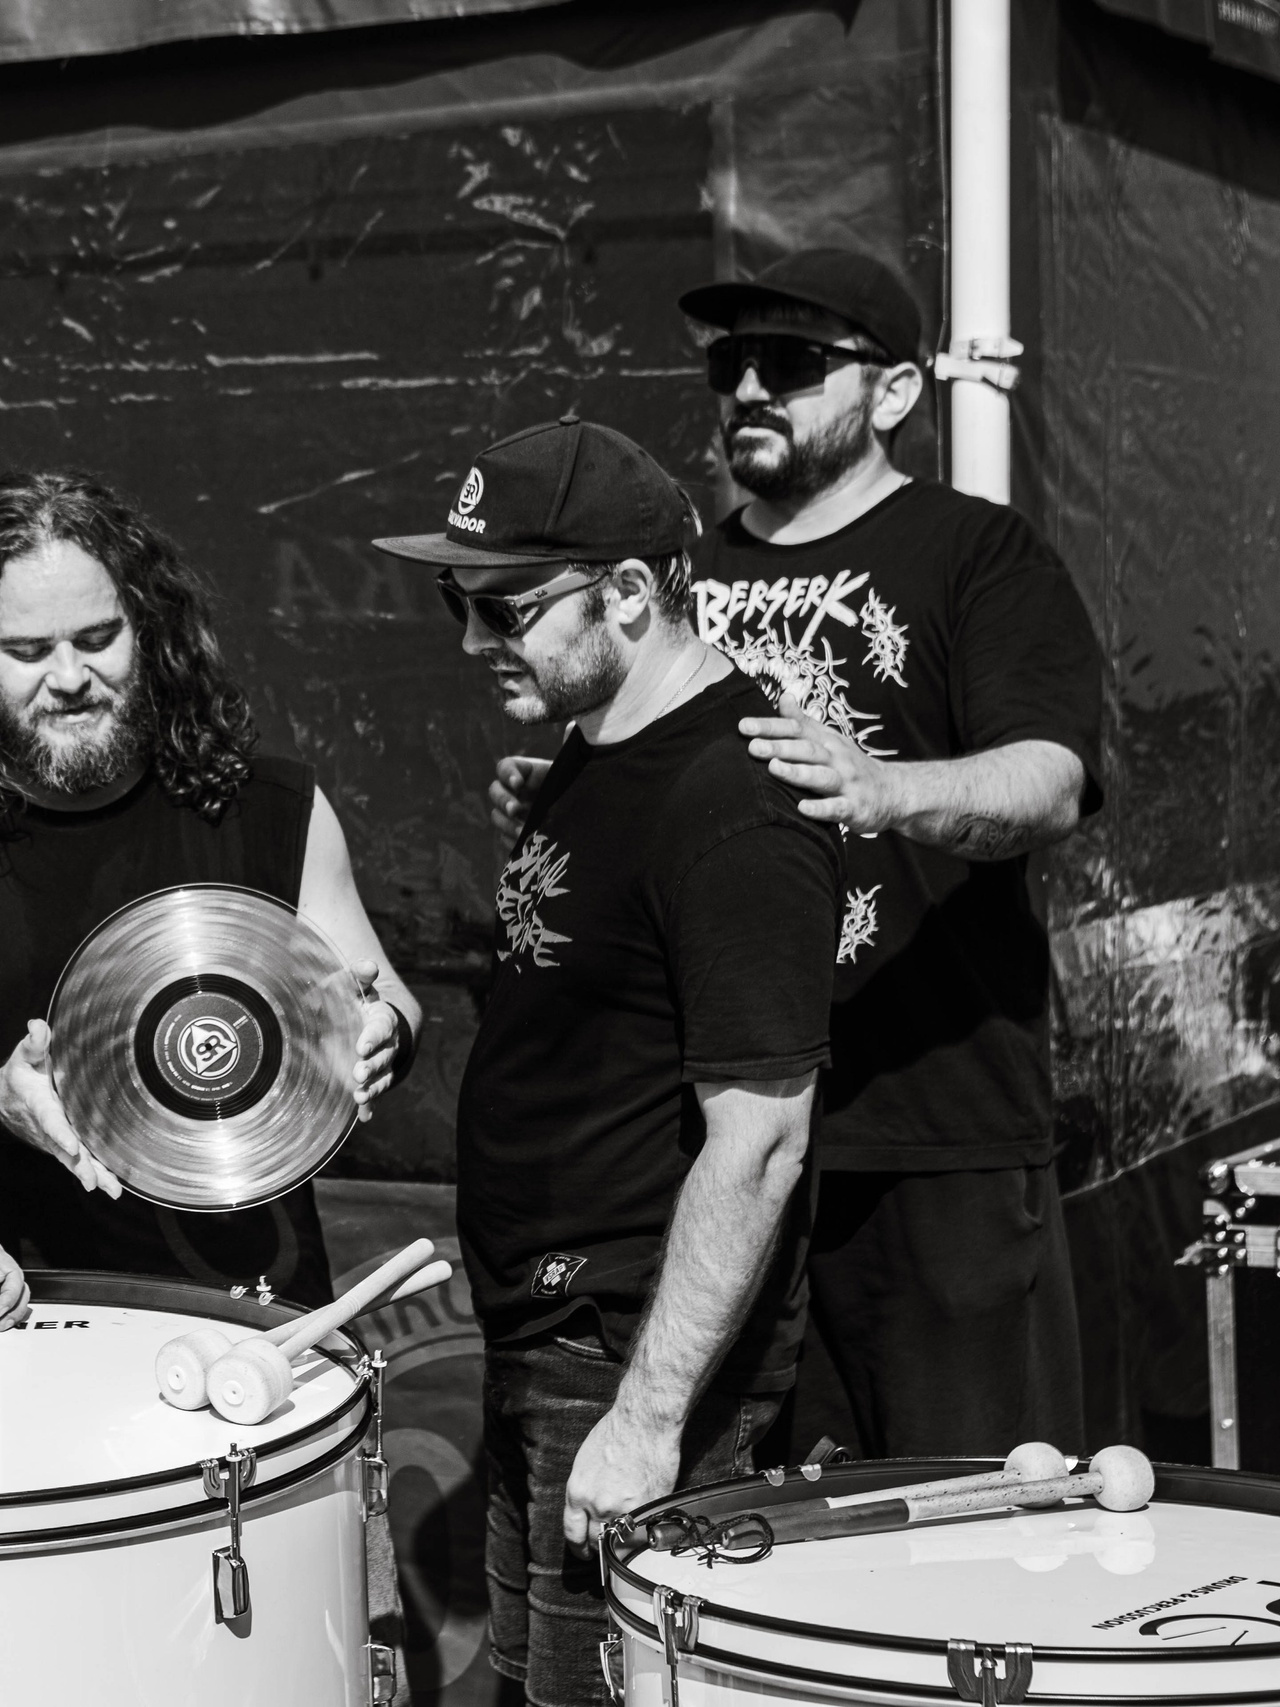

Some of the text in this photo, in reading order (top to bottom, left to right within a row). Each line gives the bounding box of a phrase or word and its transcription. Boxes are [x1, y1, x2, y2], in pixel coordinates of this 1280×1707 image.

[690, 569, 871, 651] BERSERK
[1190, 1575, 1249, 1595] DRUMS
[1091, 1597, 1188, 1631] PERCUSSION
